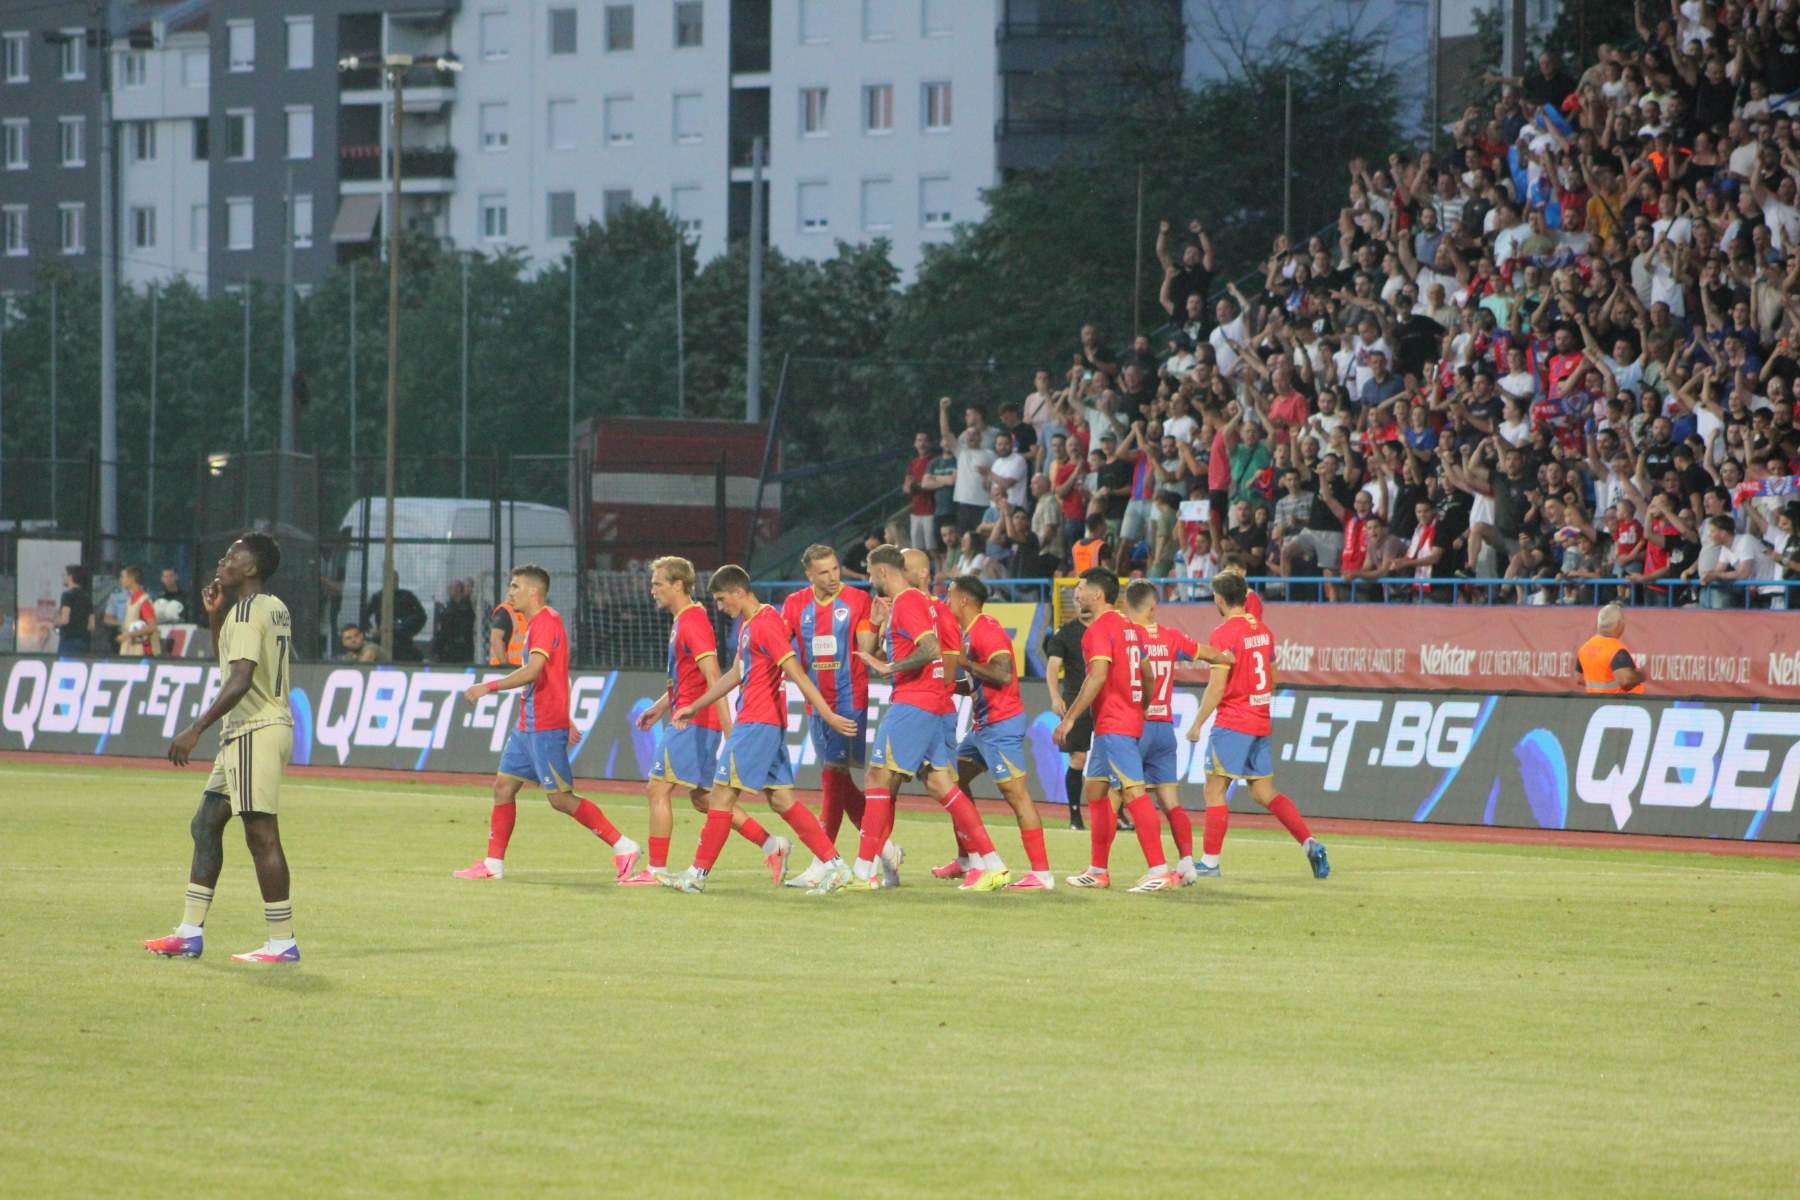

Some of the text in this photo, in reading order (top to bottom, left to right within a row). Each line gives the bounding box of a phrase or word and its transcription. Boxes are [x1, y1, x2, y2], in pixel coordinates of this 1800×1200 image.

[275, 635, 291, 697] 7
[1253, 651, 1266, 690] 3
[1275, 638, 1314, 672] ektar
[1332, 647, 1368, 672] NEKTAR
[1368, 647, 1393, 673] LAKO
[1420, 642, 1476, 676] Nektar
[1479, 650, 1493, 675] UZ
[1494, 651, 1531, 677] NEKTAR
[1532, 651, 1557, 678] LAKO
[1651, 654, 1666, 680] UZ
[1666, 654, 1706, 682] NEKTAR
[1708, 655, 1735, 683] LAKO
